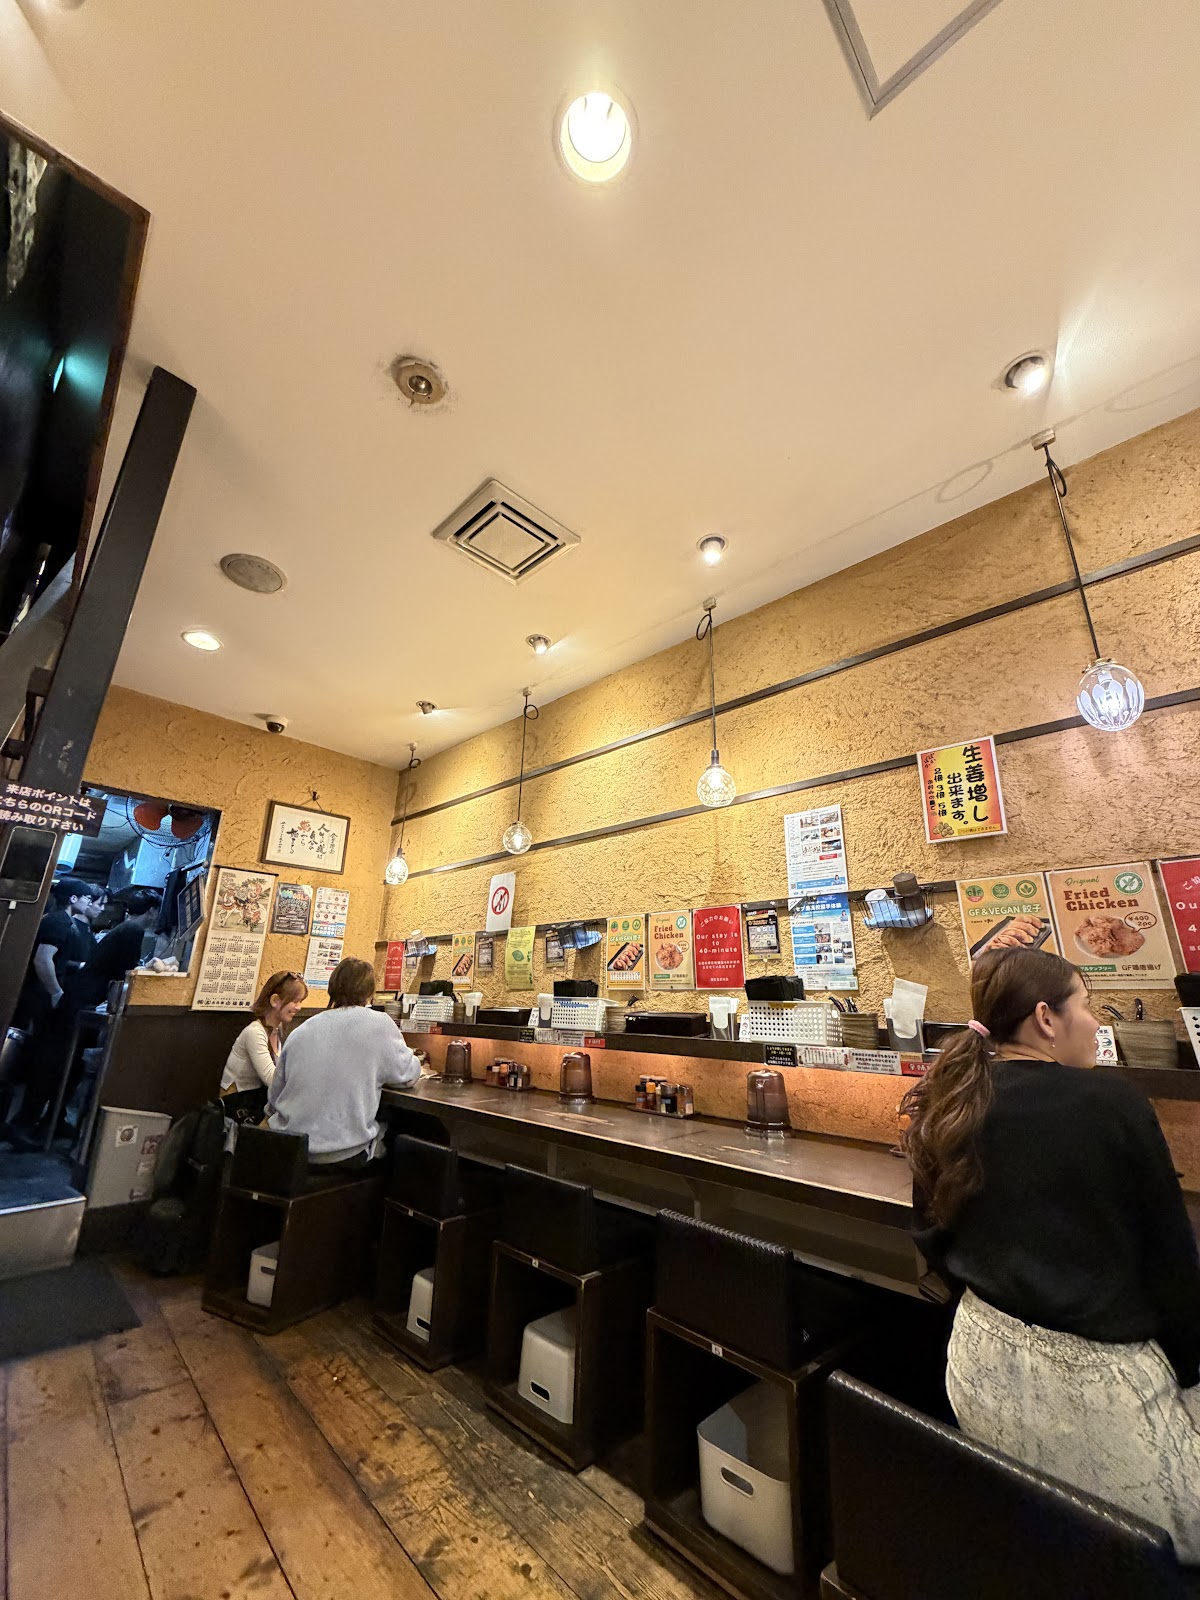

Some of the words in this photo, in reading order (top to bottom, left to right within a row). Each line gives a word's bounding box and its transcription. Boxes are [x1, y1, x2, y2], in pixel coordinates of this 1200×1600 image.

[934, 767, 943, 782] 2倍
[962, 745, 989, 822] 生姜増し
[6, 783, 91, 808] 来店ポイントは
[936, 784, 945, 800] 3倍
[947, 773, 969, 825] 出来ます。
[938, 802, 947, 817] 5倍
[1065, 876, 1100, 887] Original
[1063, 888, 1110, 900] Fried
[968, 909, 980, 917] GF
[981, 908, 989, 916] &
[989, 906, 1020, 915] VEGAN
[1023, 903, 1041, 913] 餃子
[1066, 898, 1139, 911] Chicken
[654, 924, 673, 932] Fried
[654, 932, 684, 940] Chicken
